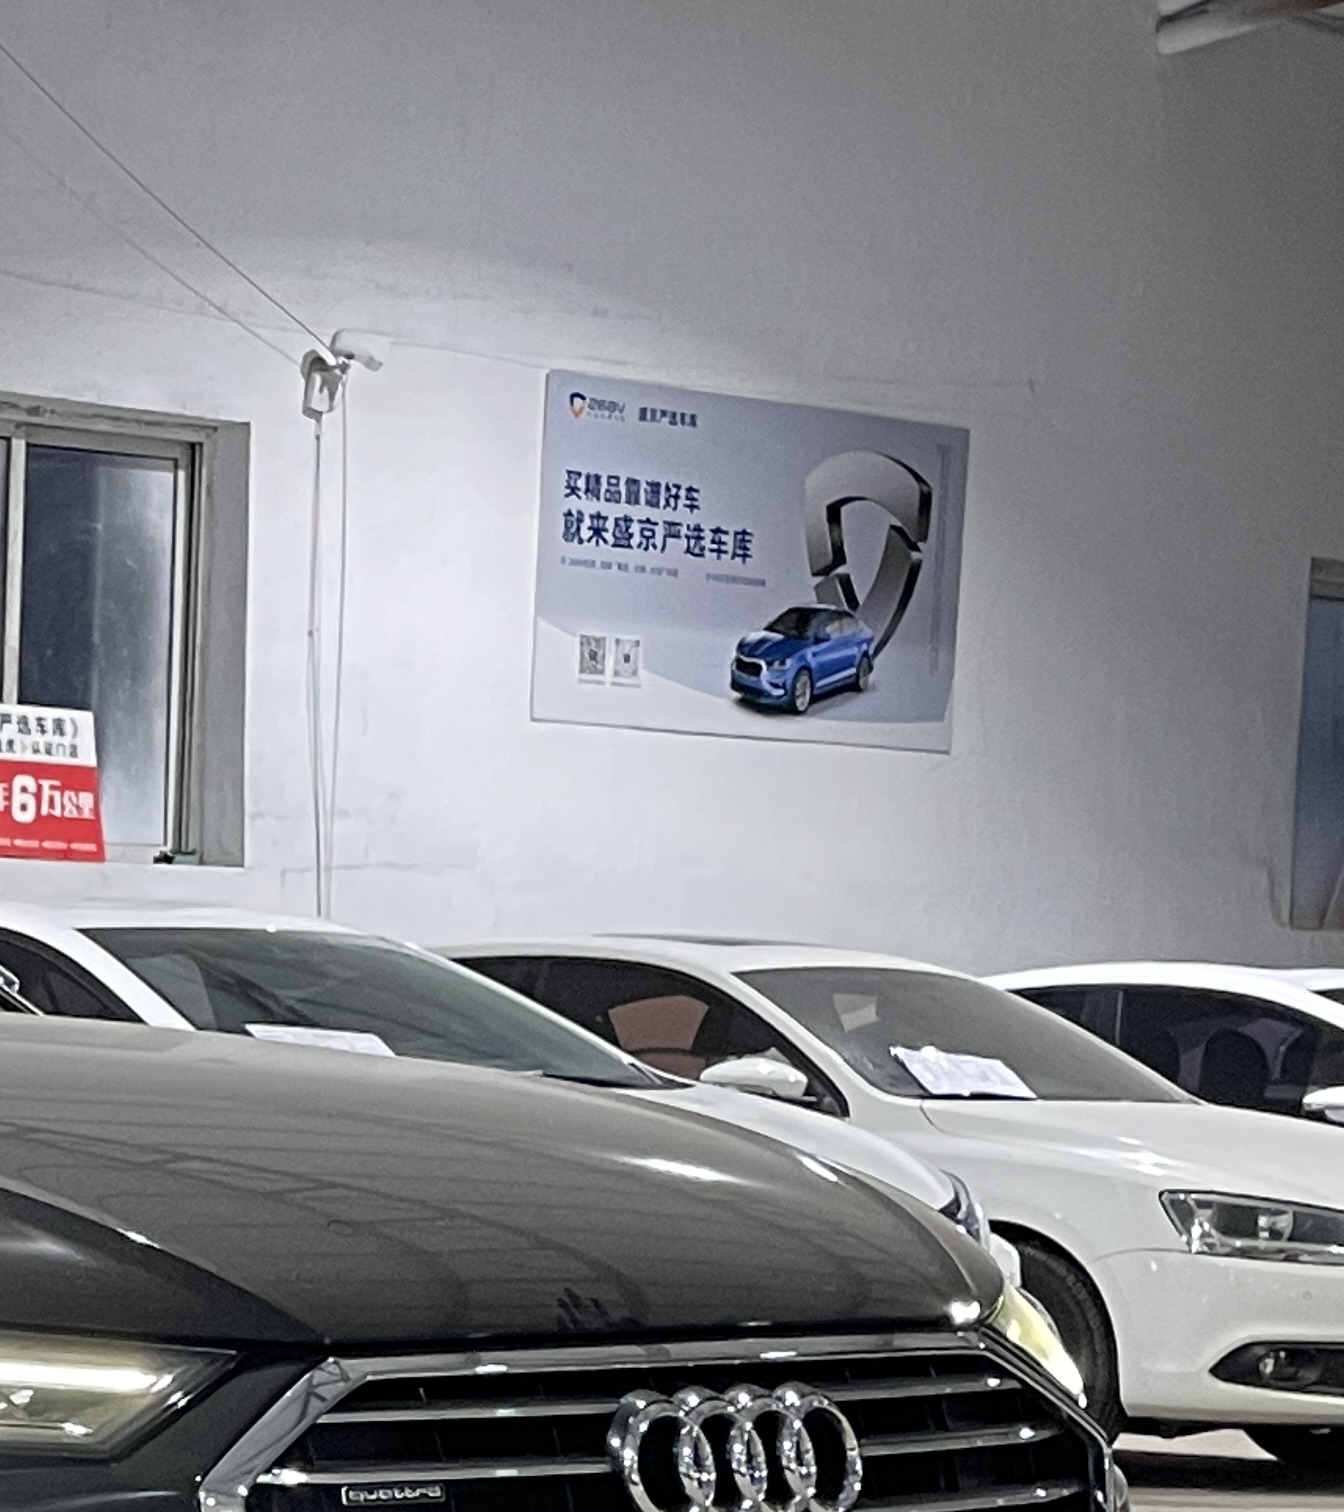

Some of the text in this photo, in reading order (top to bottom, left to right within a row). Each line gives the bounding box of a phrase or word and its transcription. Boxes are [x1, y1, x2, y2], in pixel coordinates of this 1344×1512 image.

[561, 508, 755, 565] 就来盛京严选车库
